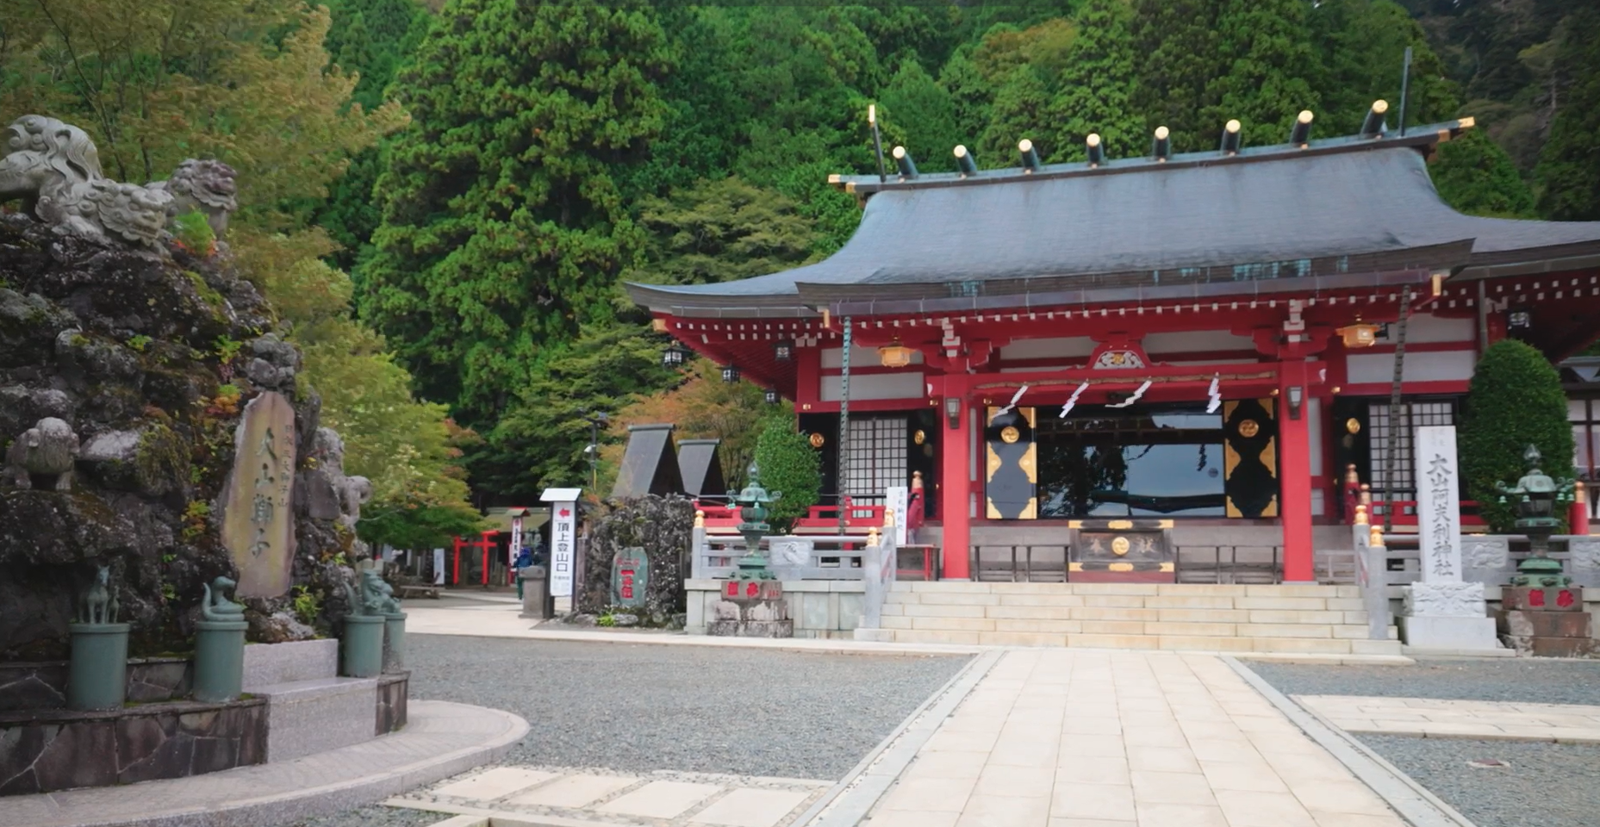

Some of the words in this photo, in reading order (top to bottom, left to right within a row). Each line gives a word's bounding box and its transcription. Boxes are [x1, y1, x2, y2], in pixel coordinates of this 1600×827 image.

[556, 522, 570, 572] 頂上登山口
[1426, 453, 1454, 576] 大山阿夫利神社
